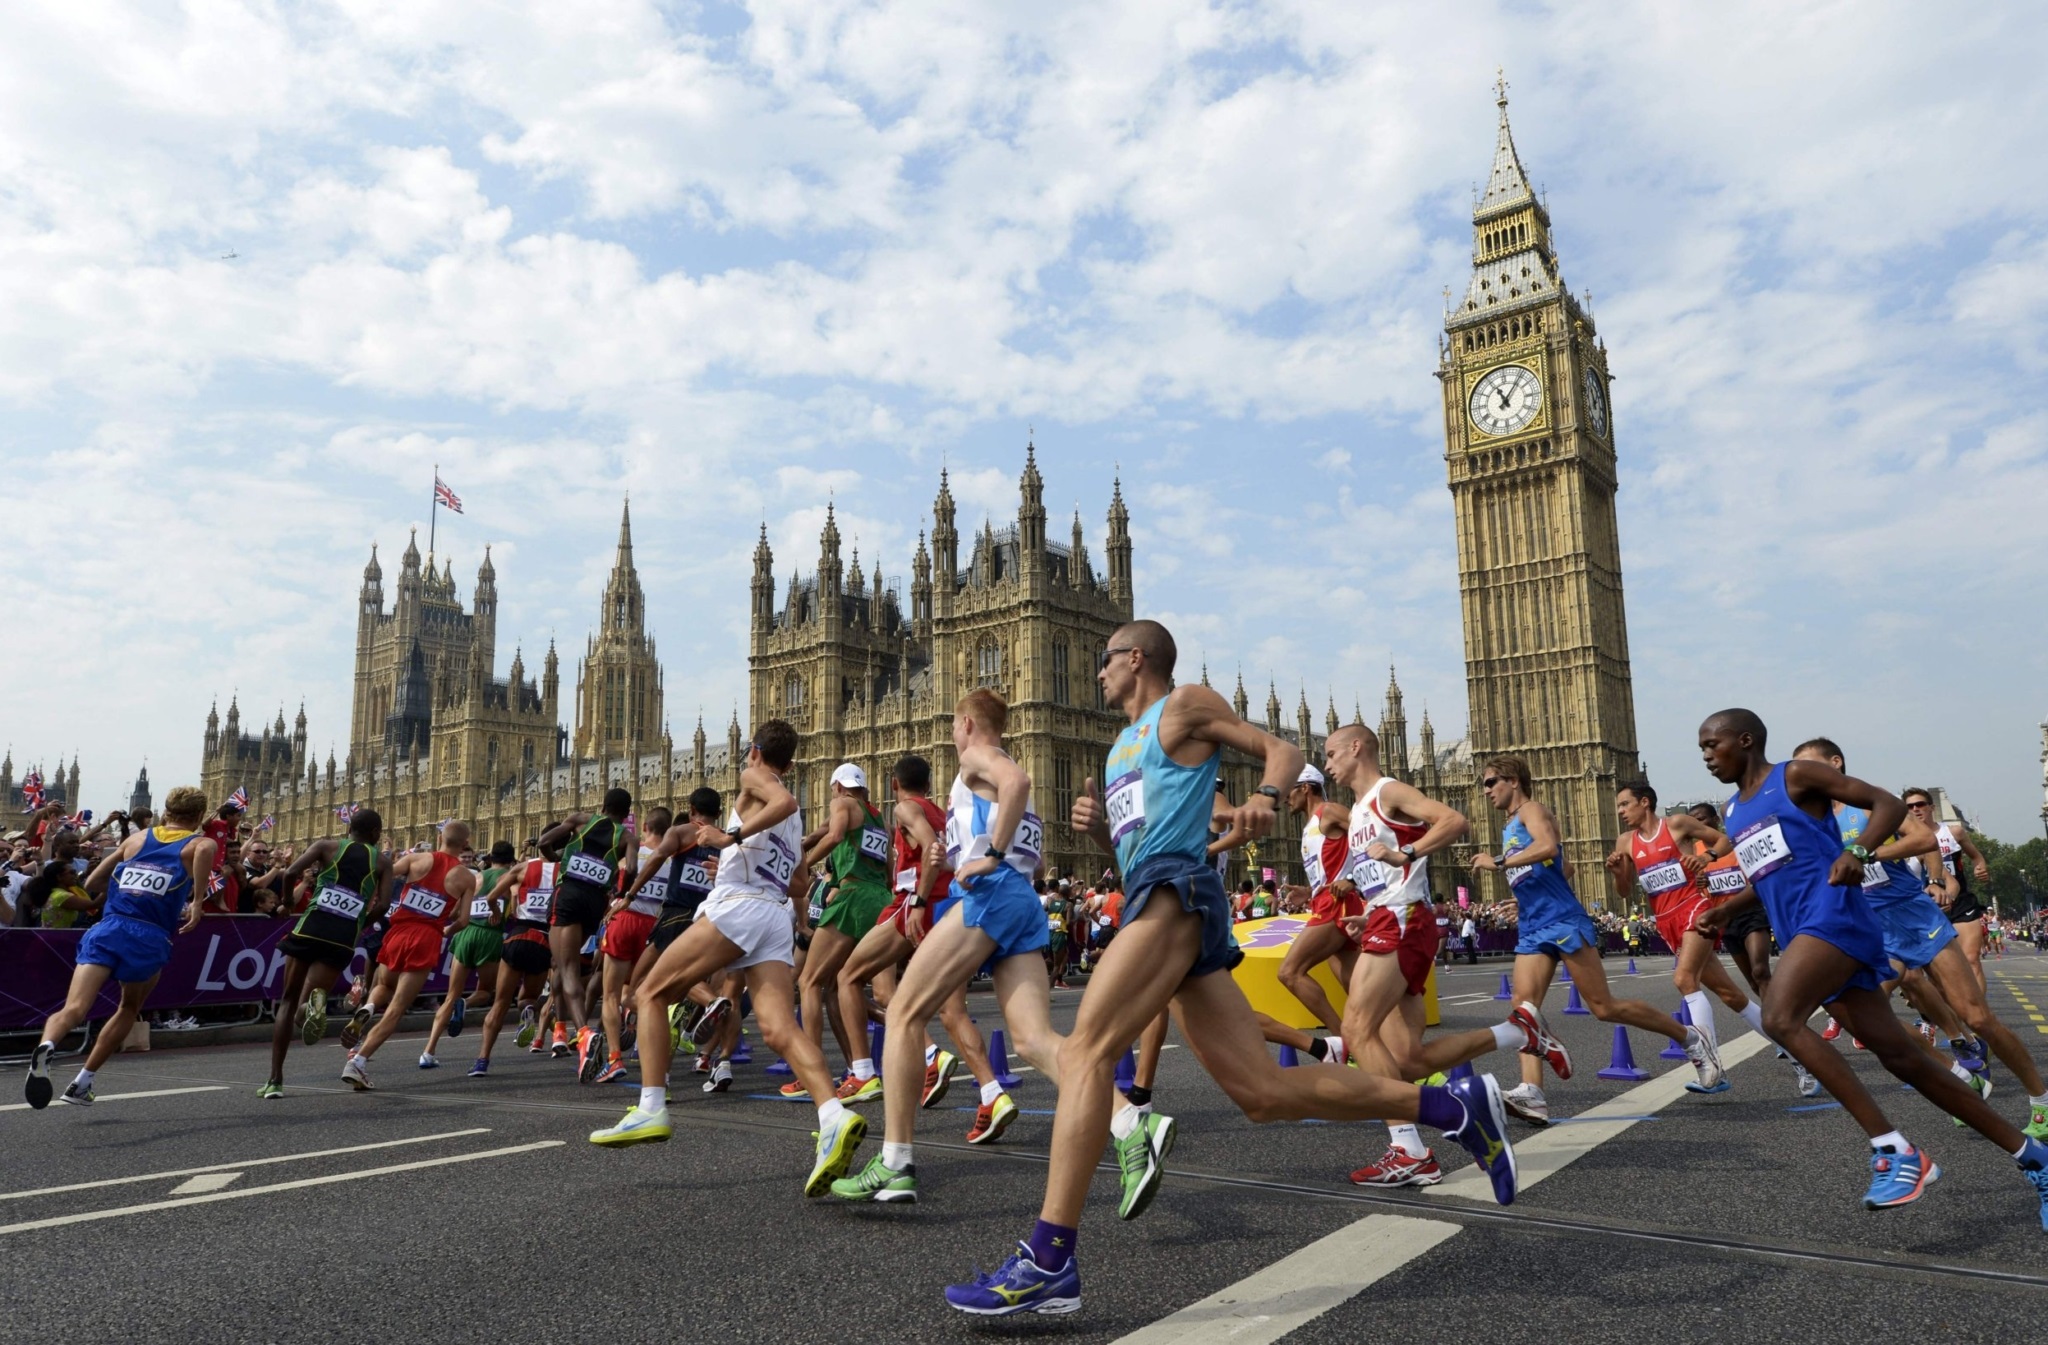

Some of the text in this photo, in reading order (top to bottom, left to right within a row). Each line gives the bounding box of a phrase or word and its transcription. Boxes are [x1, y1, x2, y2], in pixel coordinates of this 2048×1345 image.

[571, 858, 607, 881] 3368
[122, 871, 165, 891] 2760
[321, 891, 360, 912] 3367
[409, 892, 442, 912] 1167
